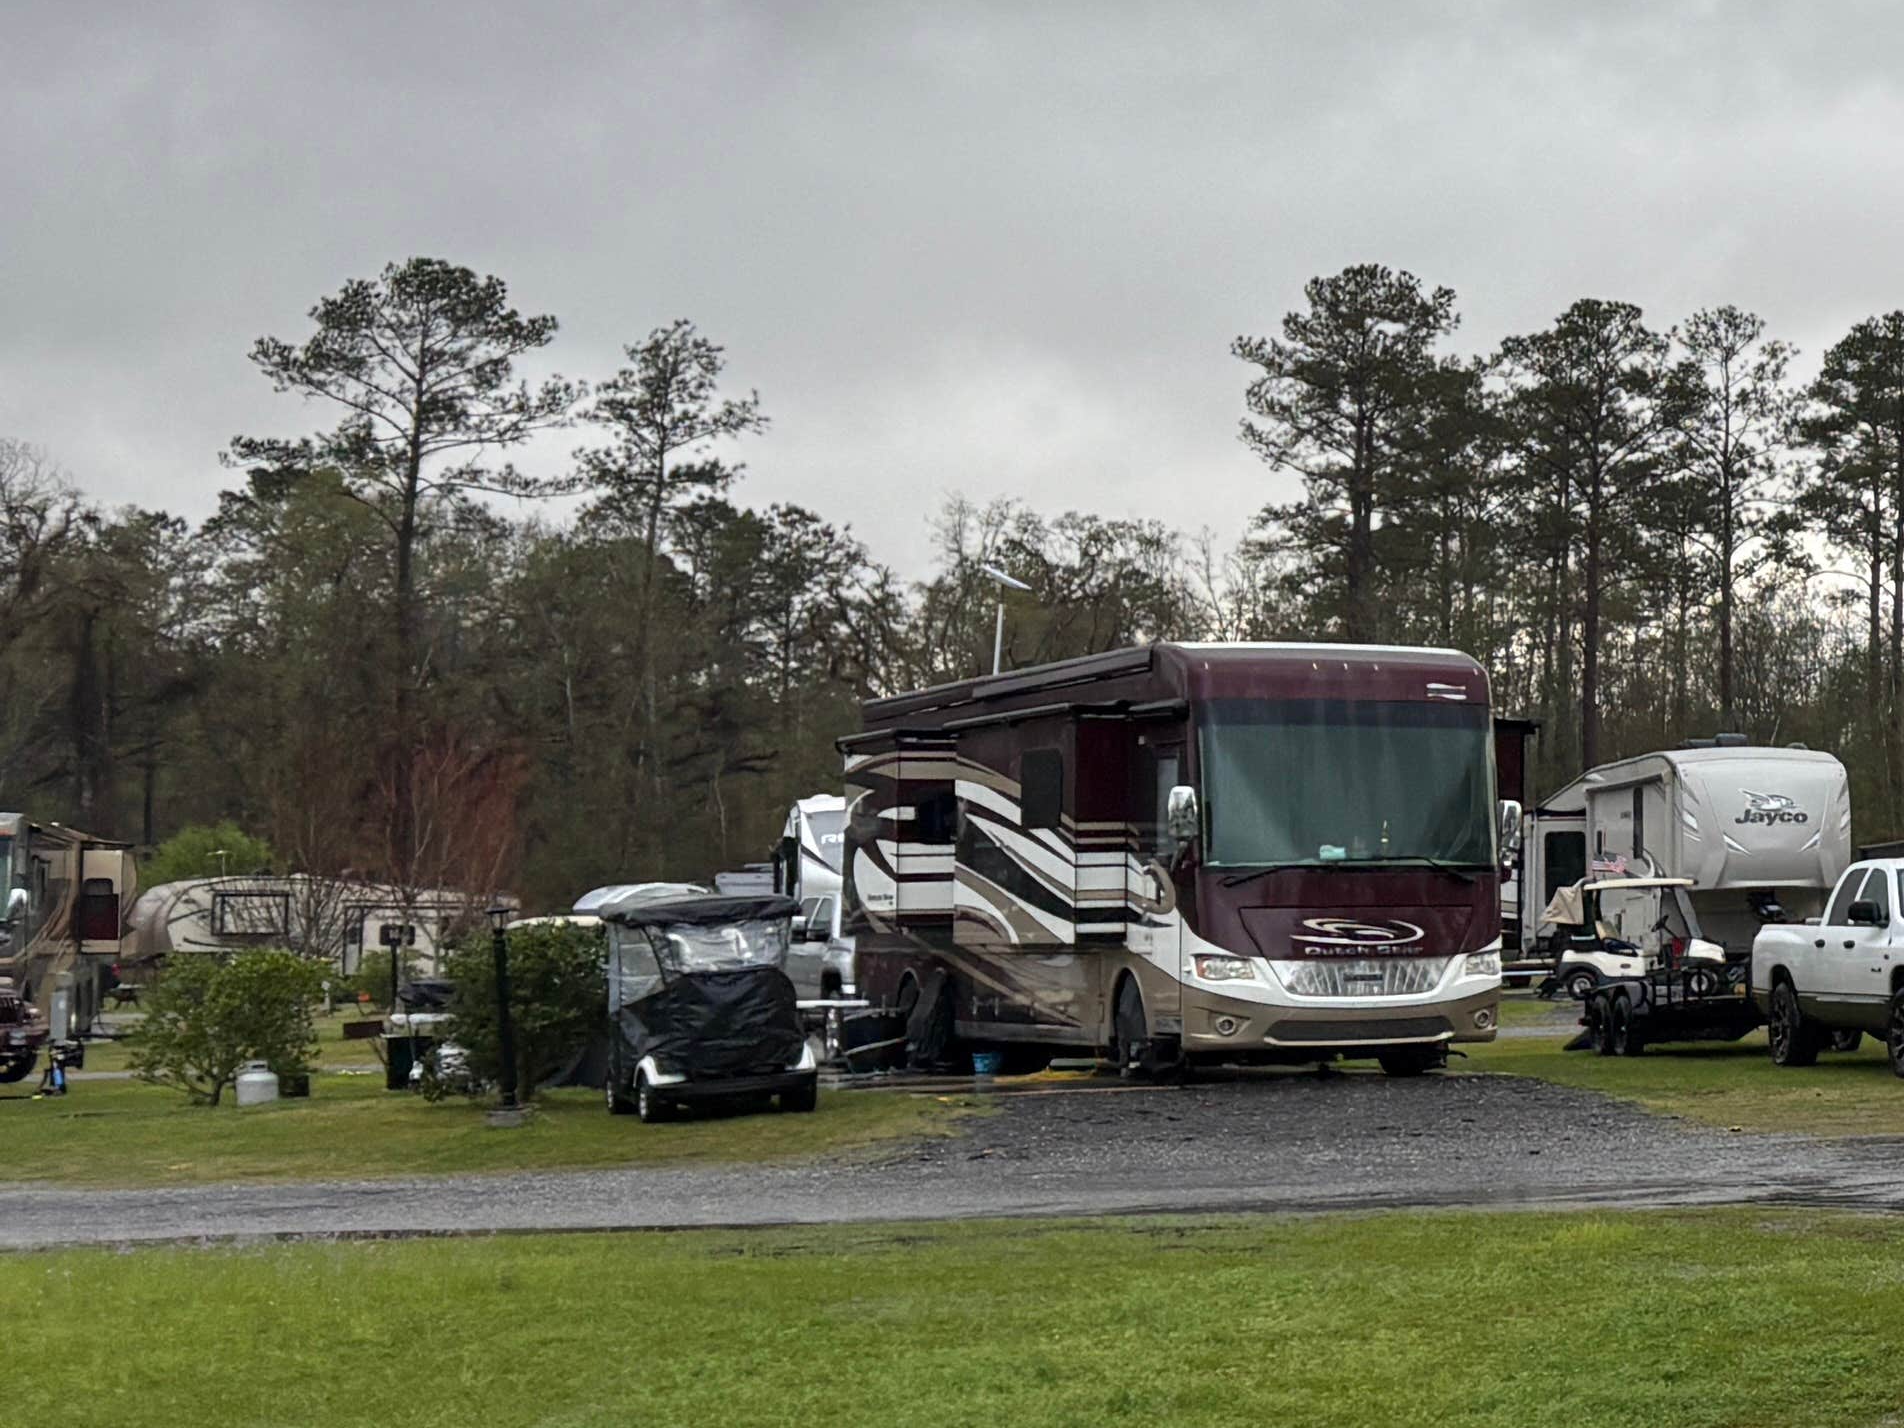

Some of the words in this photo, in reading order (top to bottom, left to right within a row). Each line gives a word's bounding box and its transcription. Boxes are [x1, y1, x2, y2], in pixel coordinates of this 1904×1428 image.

[1735, 808, 1809, 826] Jayco
[1305, 946, 1368, 956] Dutch
[1377, 945, 1424, 956] Star
